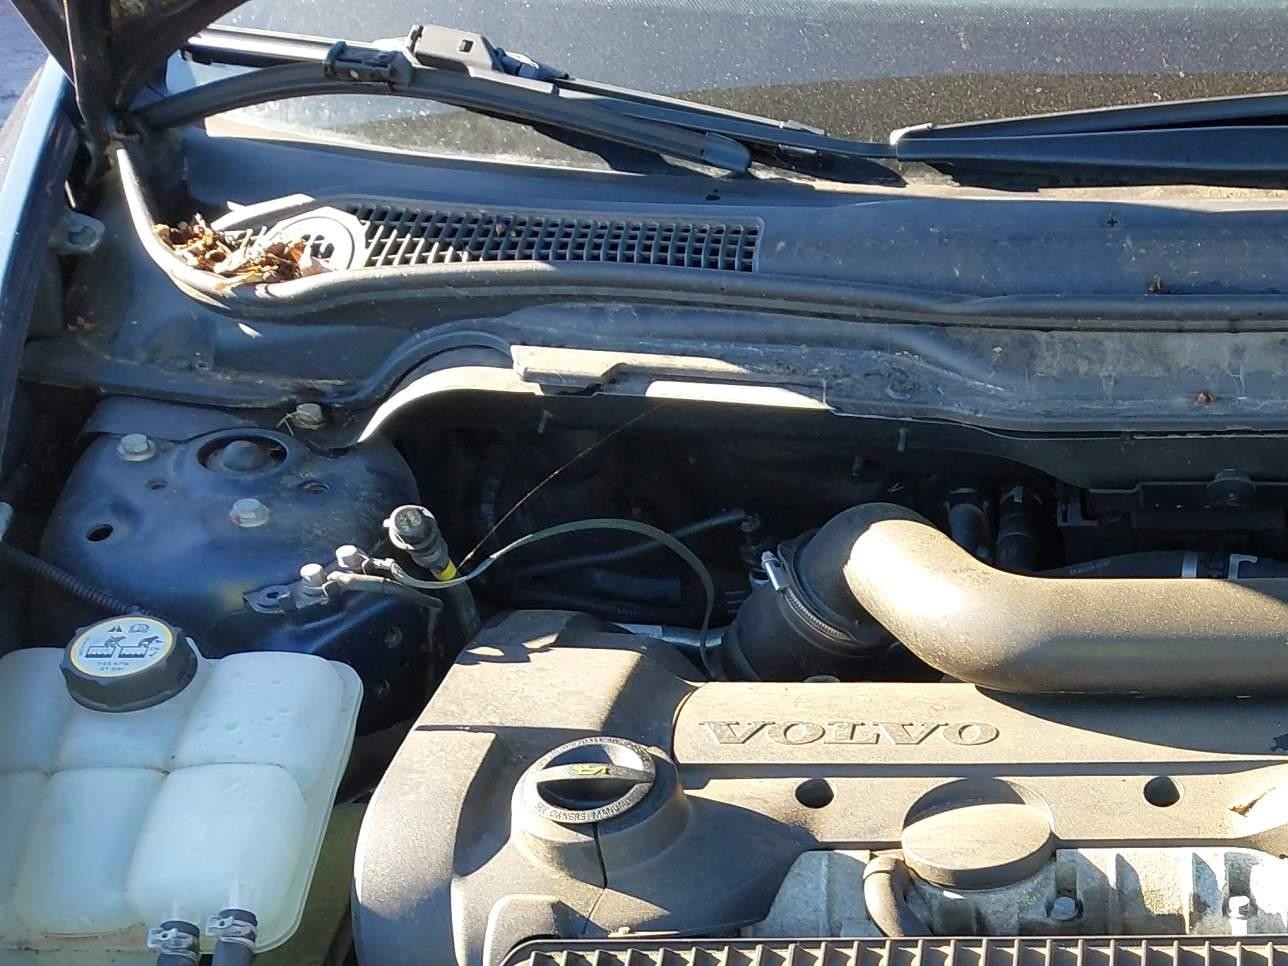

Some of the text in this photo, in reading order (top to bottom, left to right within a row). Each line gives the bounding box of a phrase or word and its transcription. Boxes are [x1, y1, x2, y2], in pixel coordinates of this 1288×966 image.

[698, 720, 1000, 746] VOLVO
[549, 809, 587, 821] OWNERS
[592, 797, 633, 820] MANUAL
